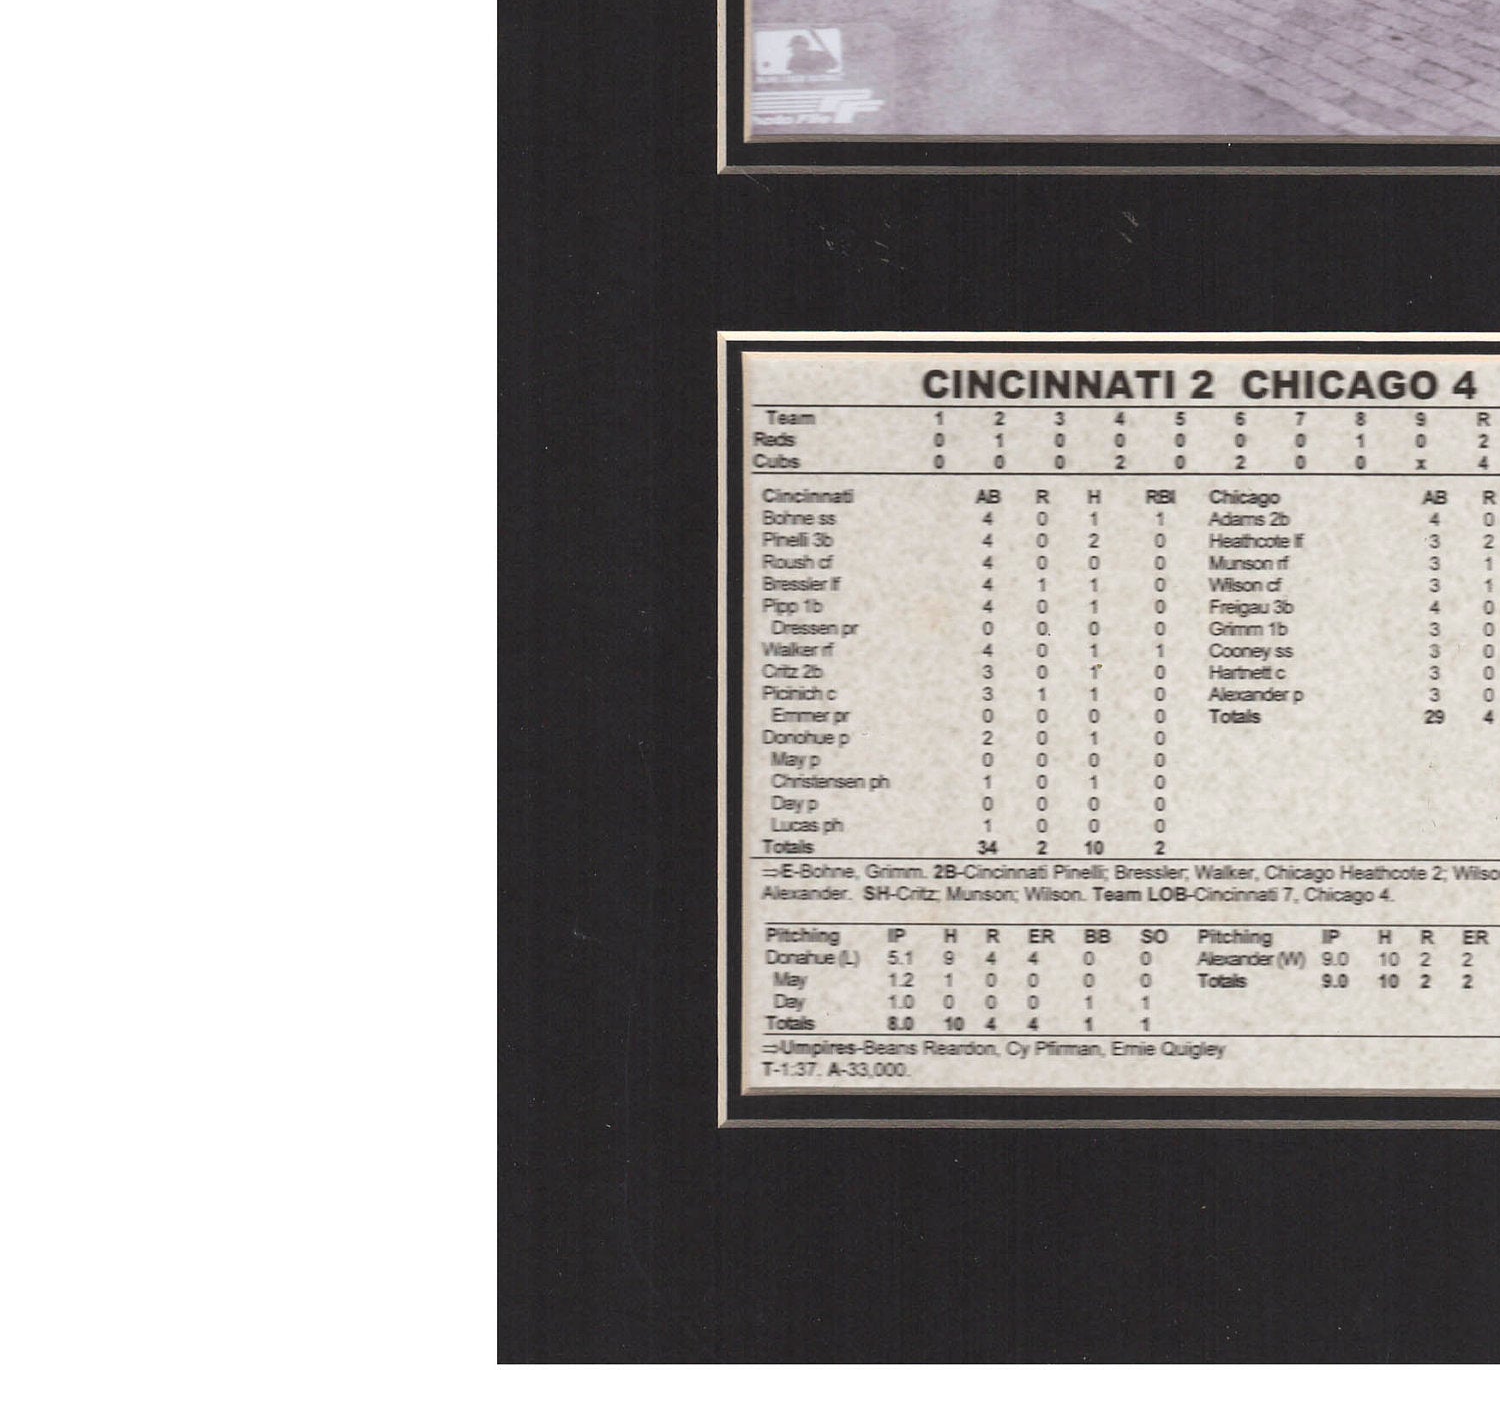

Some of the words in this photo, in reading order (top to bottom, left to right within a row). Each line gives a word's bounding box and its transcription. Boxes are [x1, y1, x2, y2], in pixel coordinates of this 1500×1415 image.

[921, 369, 1176, 400] CINCINNATI
[1189, 369, 1215, 400] 2
[1241, 369, 1439, 401] CHICAGO
[1451, 370, 1478, 400] 4
[765, 409, 816, 426] Team
[934, 410, 944, 426] 1
[993, 410, 1006, 427] 2
[1054, 410, 1066, 427] 3
[1114, 411, 1126, 426] 4
[1175, 411, 1186, 427] 5
[1234, 411, 1246, 427] 6
[1295, 410, 1307, 426] 7
[1355, 411, 1367, 427] 8
[1415, 411, 1427, 427] 9
[1476, 411, 1491, 427] R
[761, 487, 854, 504] Cincinnati
[975, 488, 1002, 505] AB
[1035, 488, 1050, 505] R
[1087, 489, 1101, 505] H
[1145, 489, 1177, 505] RBI
[1208, 489, 1281, 509] Chicago
[1421, 489, 1448, 506] AB
[1482, 489, 1496, 505] R
[762, 531, 809, 548] Pinelli
[812, 531, 834, 548] 3b
[981, 533, 994, 548] 4
[1036, 532, 1048, 549] 0
[1088, 532, 1100, 549] 2
[1154, 532, 1166, 549] 0
[1209, 598, 1270, 618] Freigau
[1273, 599, 1295, 615] 3b
[1429, 600, 1441, 614] 4
[1483, 599, 1495, 616] 0
[1208, 708, 1262, 725] Totals
[1424, 709, 1445, 725] 29
[1482, 709, 1495, 725] 4
[1198, 928, 1273, 949] Pitching
[1322, 928, 1341, 944] IP
[1378, 929, 1392, 945] H
[1420, 929, 1435, 945] R
[1462, 929, 1489, 946] ER
[1007, 1040, 1031, 1060] Cy
[1160, 1040, 1226, 1060] Quigley
